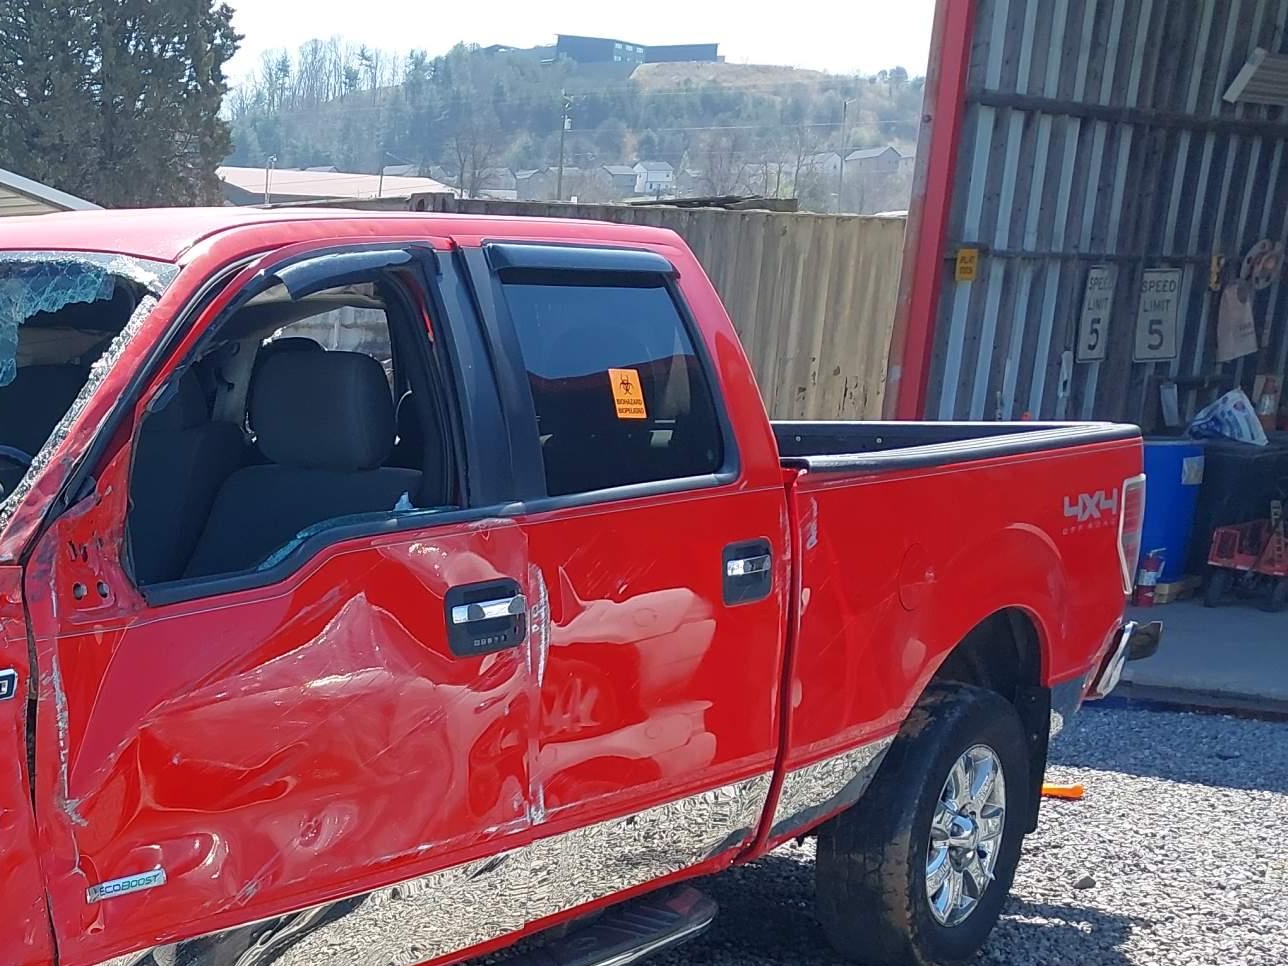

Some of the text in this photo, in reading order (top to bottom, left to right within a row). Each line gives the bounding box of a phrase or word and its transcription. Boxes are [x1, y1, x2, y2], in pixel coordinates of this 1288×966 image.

[1141, 279, 1177, 293] SPEED
[1143, 299, 1171, 312] LIMIT
[1087, 317, 1102, 351] 5
[1147, 319, 1164, 350] 5
[1063, 488, 1118, 522] 4X4
